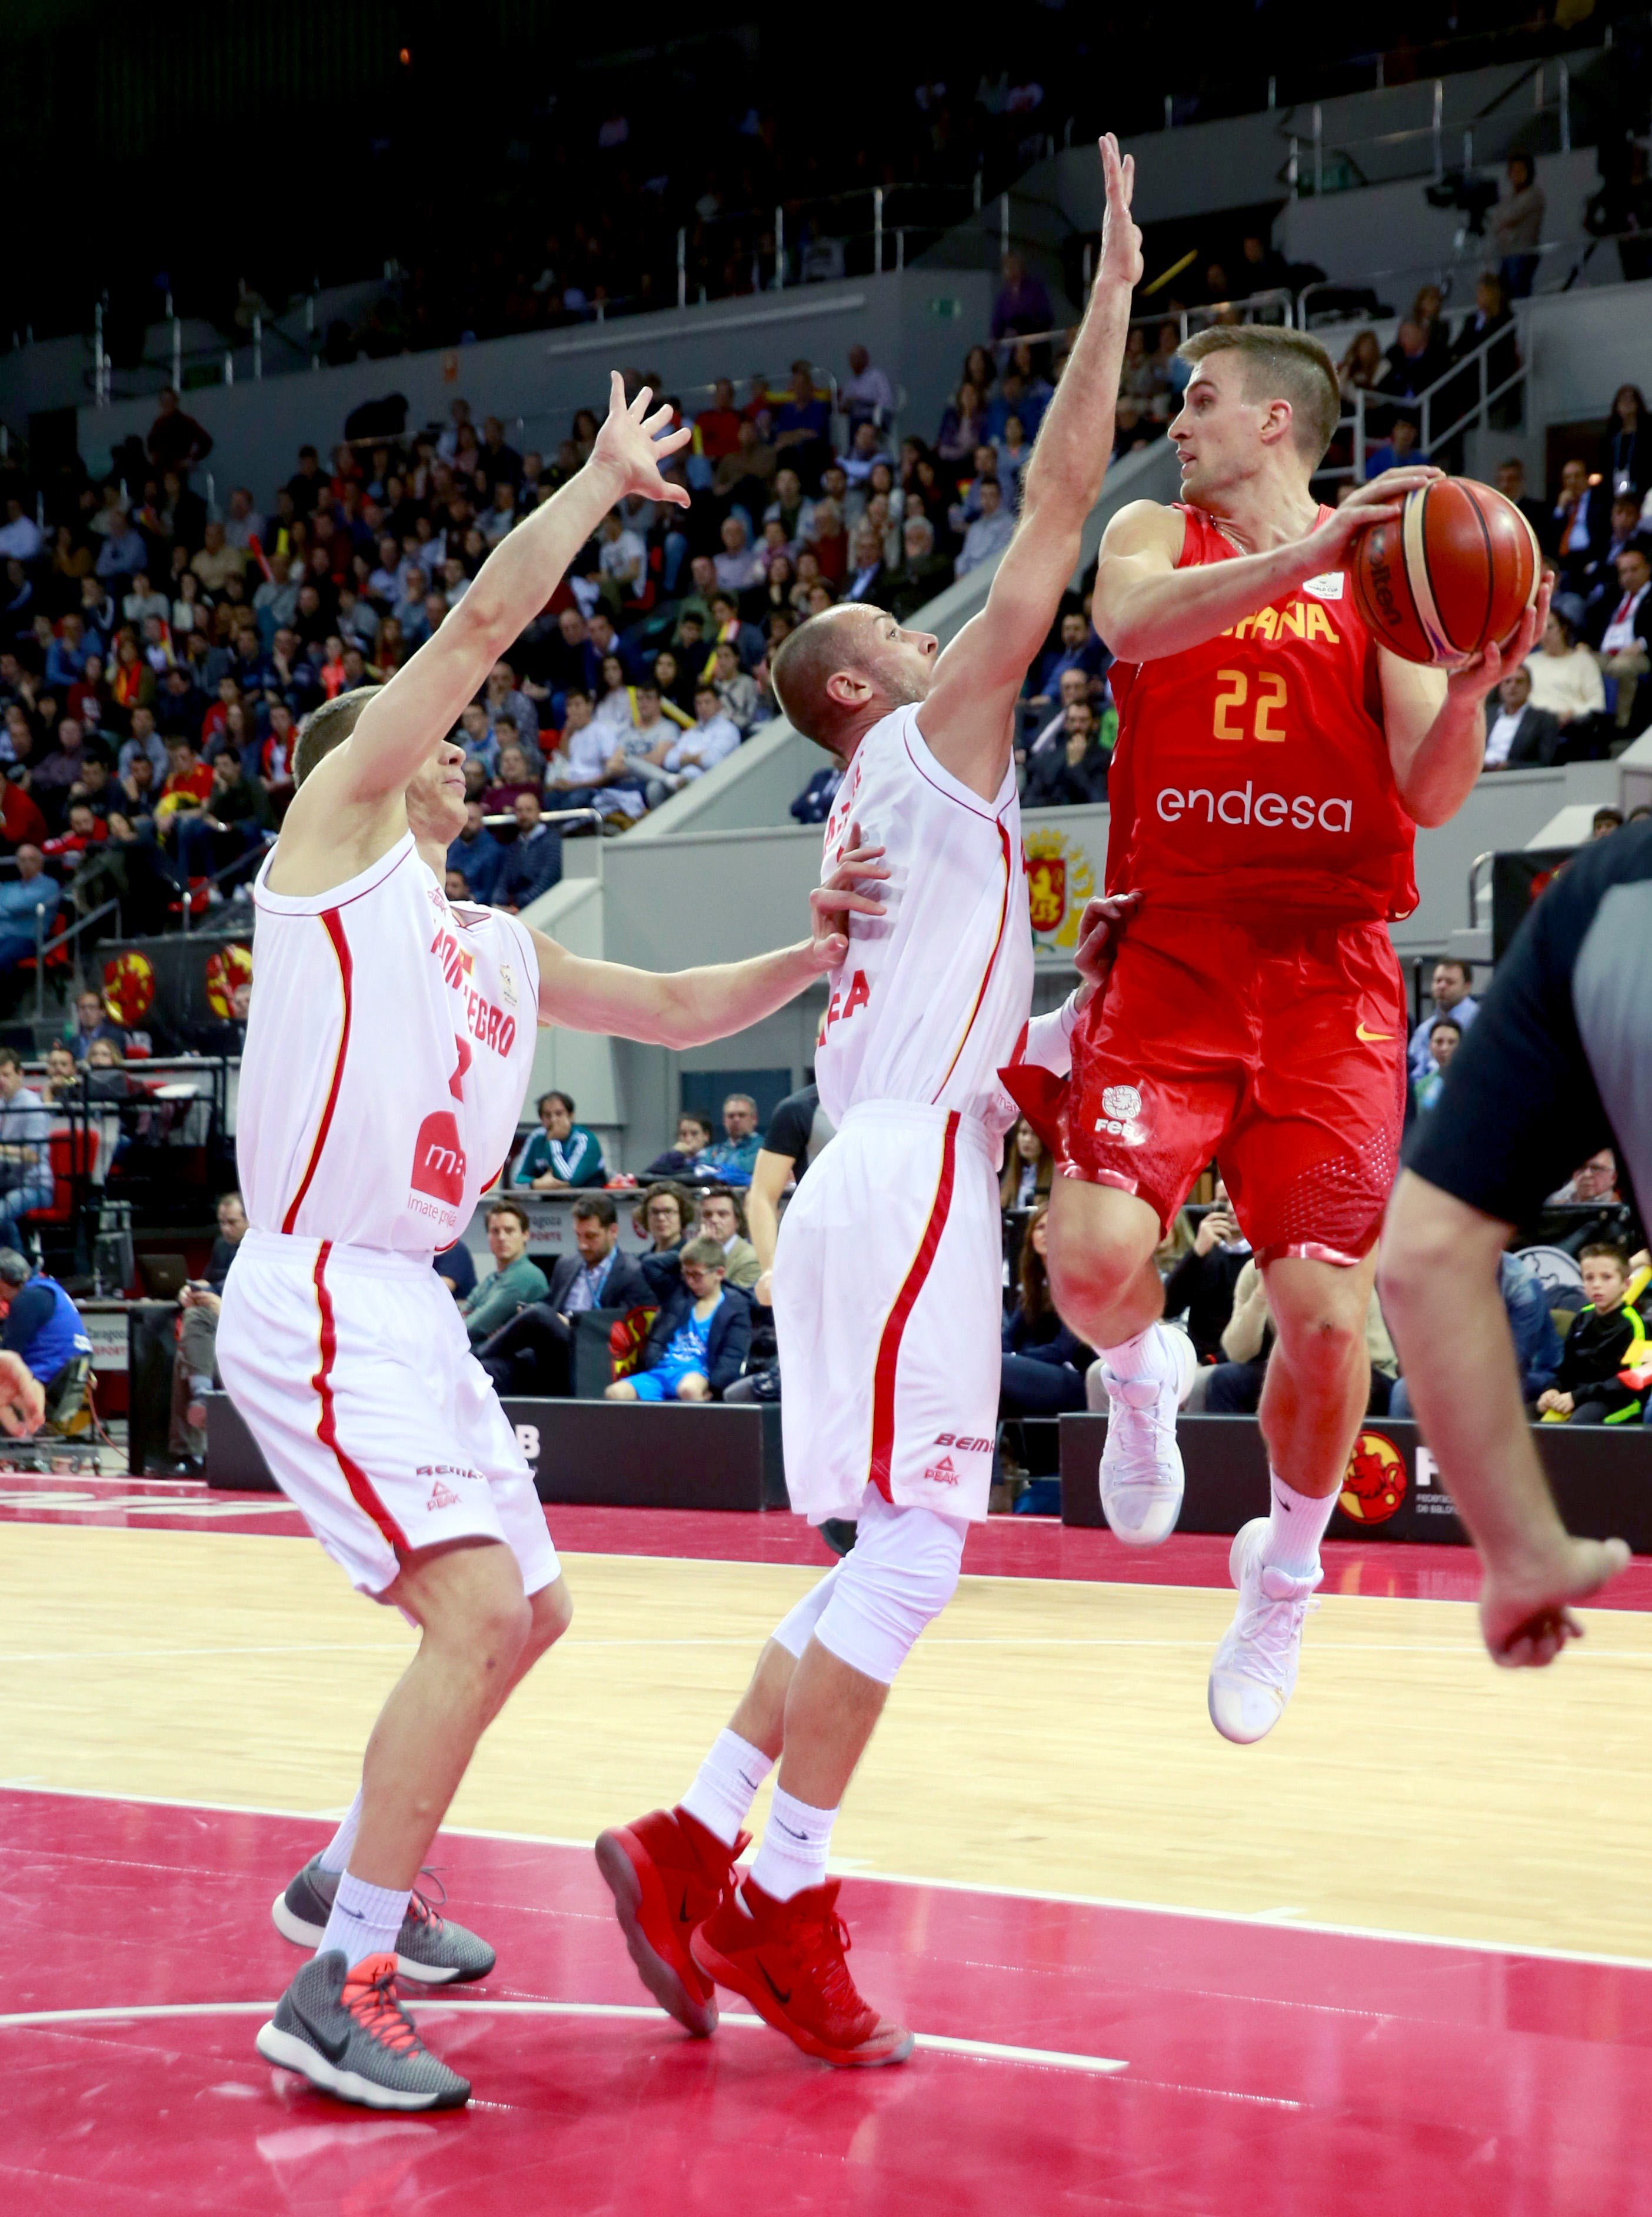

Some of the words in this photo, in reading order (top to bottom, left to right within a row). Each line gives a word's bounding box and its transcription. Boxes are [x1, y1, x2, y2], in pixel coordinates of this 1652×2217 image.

[1213, 669, 1288, 743] 22
[1155, 780, 1353, 833] endesa
[924, 1468, 961, 1486] PEAK
